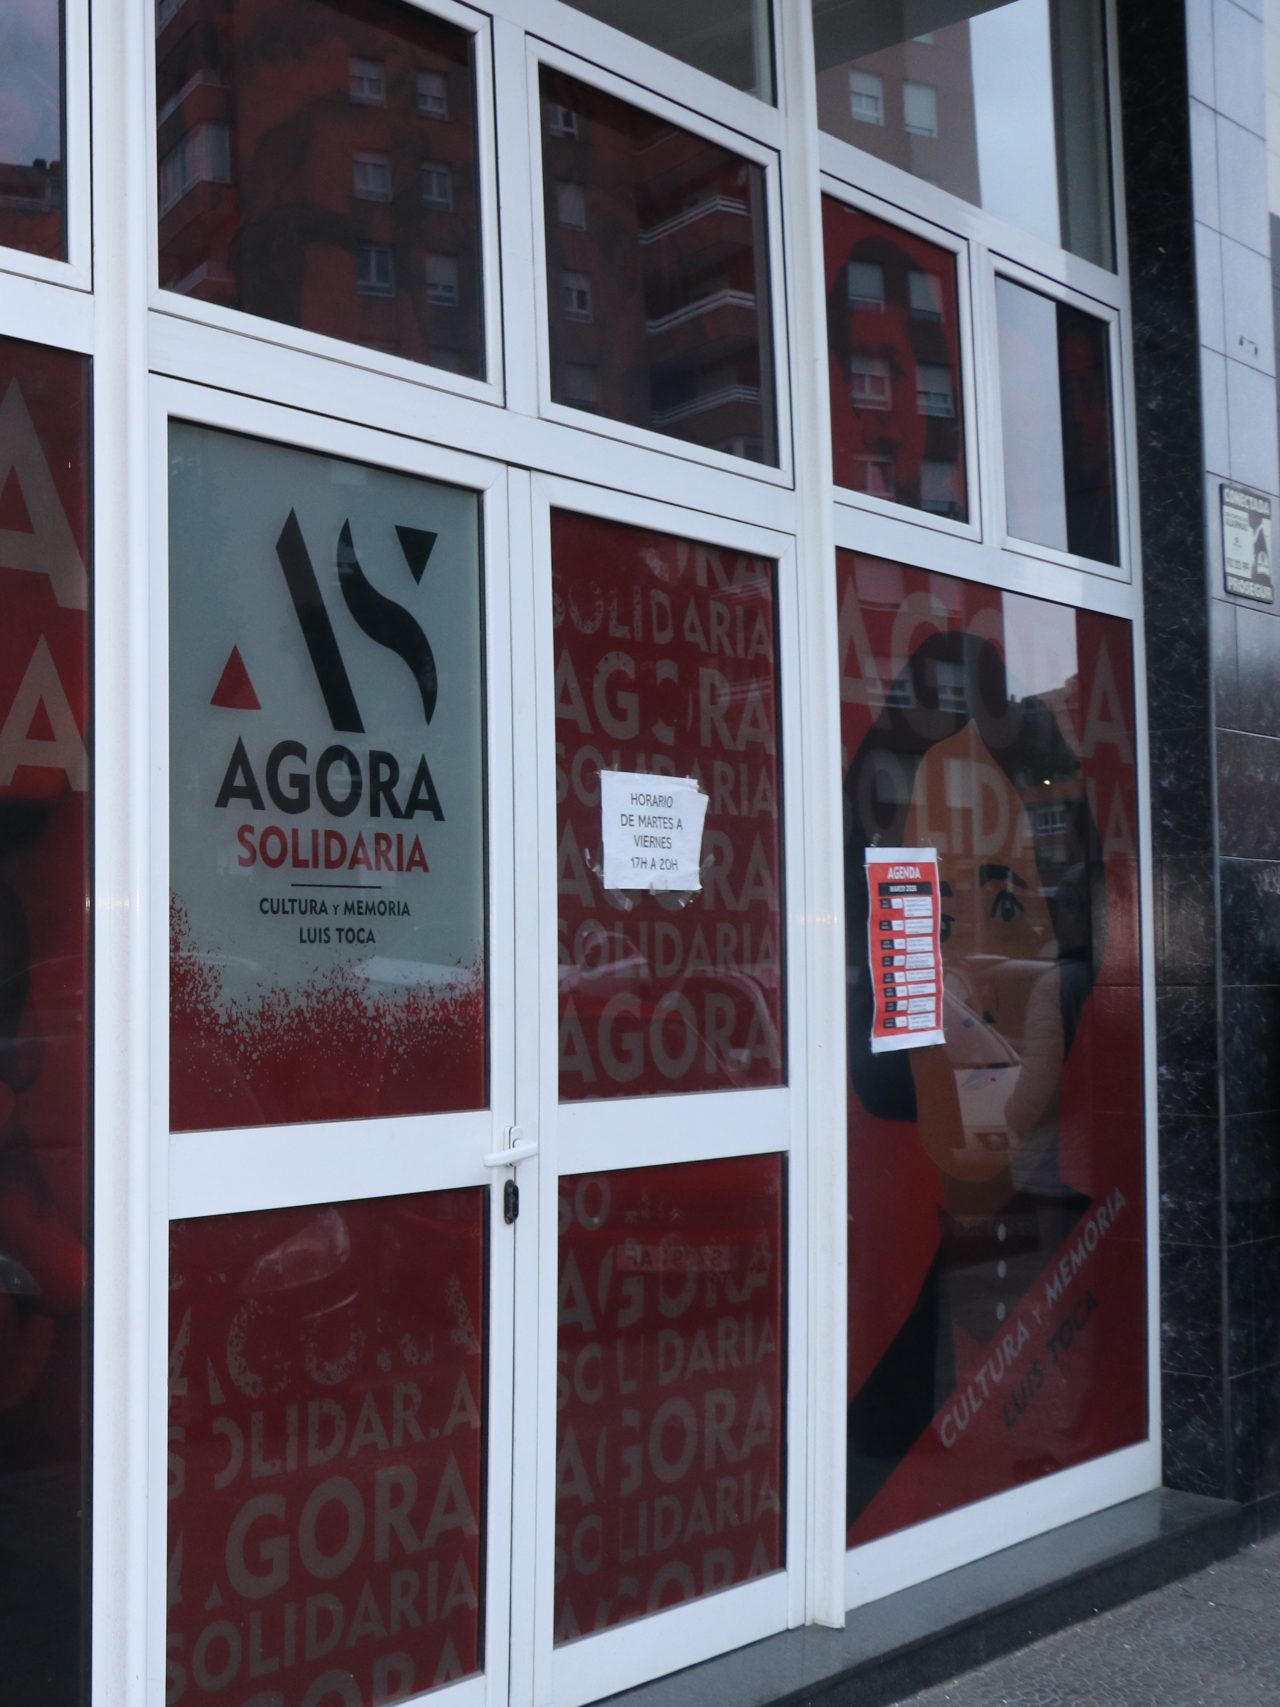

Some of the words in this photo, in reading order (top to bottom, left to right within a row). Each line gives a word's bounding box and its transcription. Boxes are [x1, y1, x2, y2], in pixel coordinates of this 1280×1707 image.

[215, 736, 445, 821] AGORA
[556, 744, 778, 820] SOARIA
[630, 793, 674, 808] HORARIO
[620, 814, 635, 826] DE
[638, 815, 674, 830] MARTES
[676, 818, 684, 831] A
[633, 835, 673, 849] VIERNES
[238, 824, 430, 873] SOLIDARIA
[558, 820, 778, 913] ARA
[630, 857, 648, 870] 17H
[650, 858, 657, 870] A
[659, 858, 679, 871] 20H
[888, 866, 922, 880] AGENDA
[259, 898, 329, 917] CULTURA
[343, 900, 411, 918] MEMORIA
[299, 927, 332, 945] LUIS
[336, 928, 376, 945] TOCA
[558, 990, 781, 1084] AGORA
[939, 1320, 1032, 1448] CULTURA
[1045, 1187, 1127, 1309] MEMORIA
[558, 1312, 776, 1411] SOLDARIA
[1002, 1360, 1047, 1431] LUIS
[1047, 1291, 1099, 1363] TOCA
